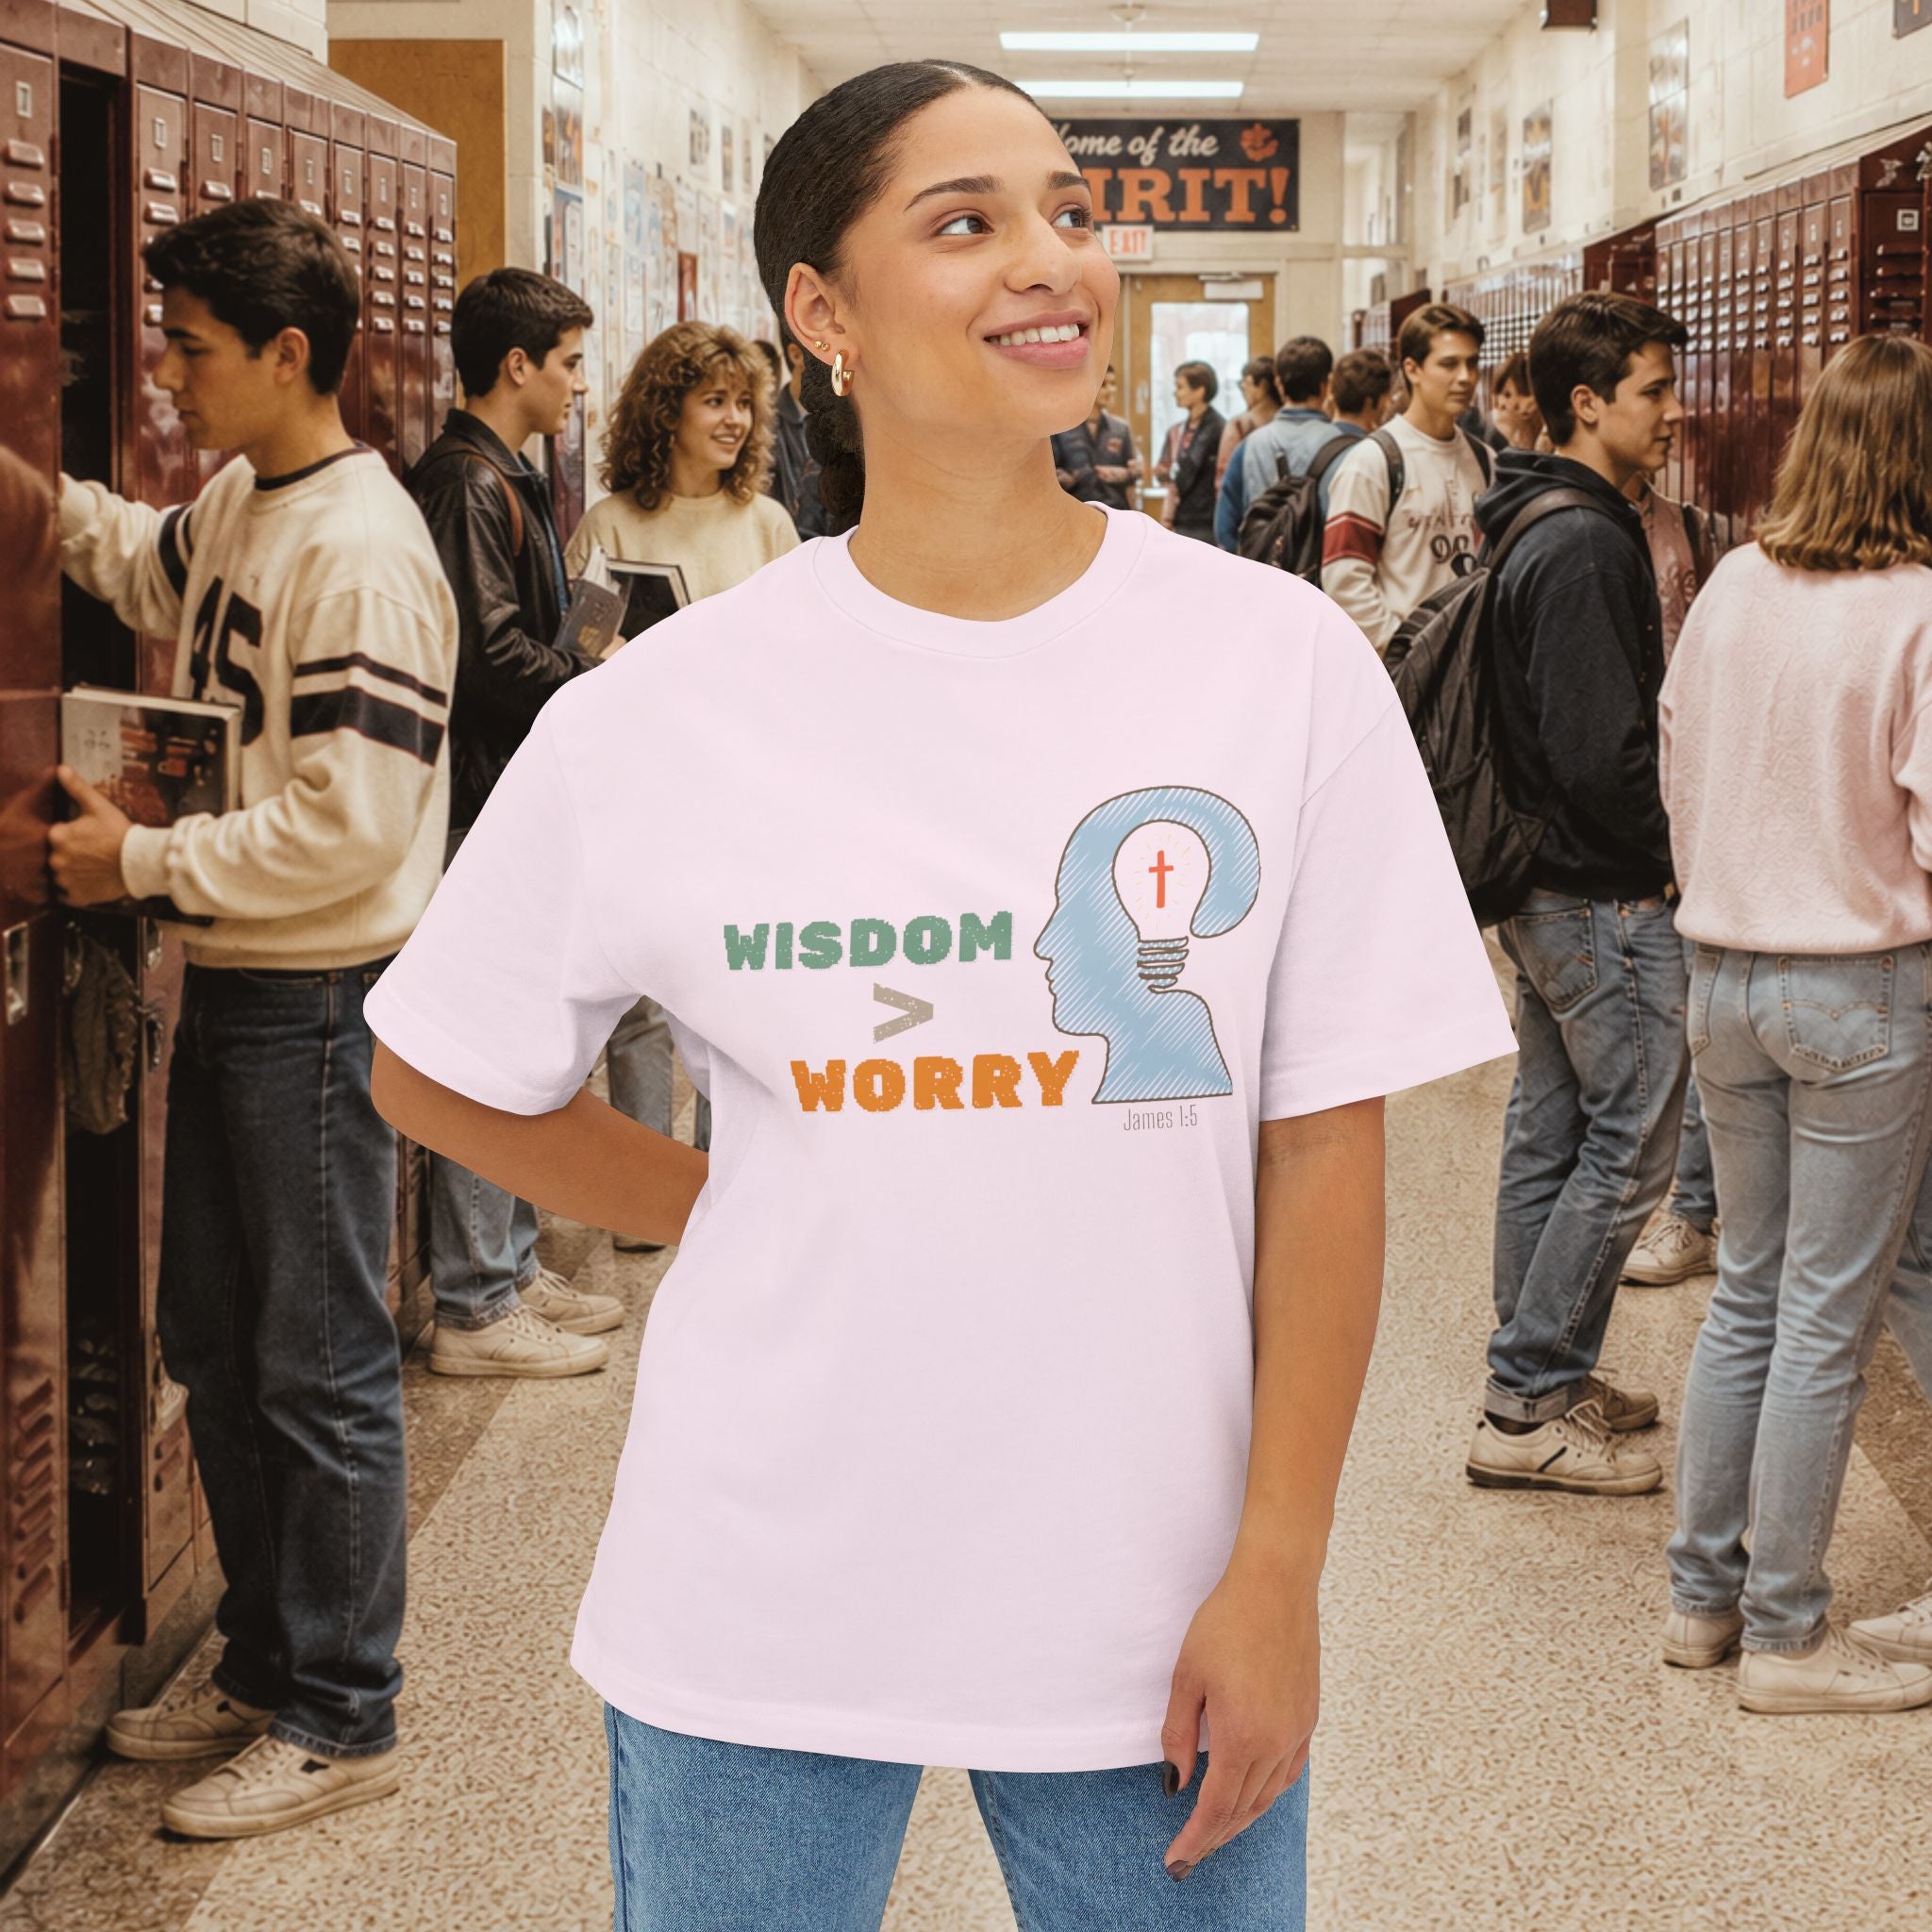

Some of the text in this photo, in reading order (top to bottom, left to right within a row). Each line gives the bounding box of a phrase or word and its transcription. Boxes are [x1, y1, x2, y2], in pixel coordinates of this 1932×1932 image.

[1127, 125, 1164, 166] of
[1168, 124, 1219, 157] the
[724, 911, 1012, 971] WISDOM
[790, 1050, 1079, 1112] WORRY
[1124, 1104, 1197, 1130] James 1:5
